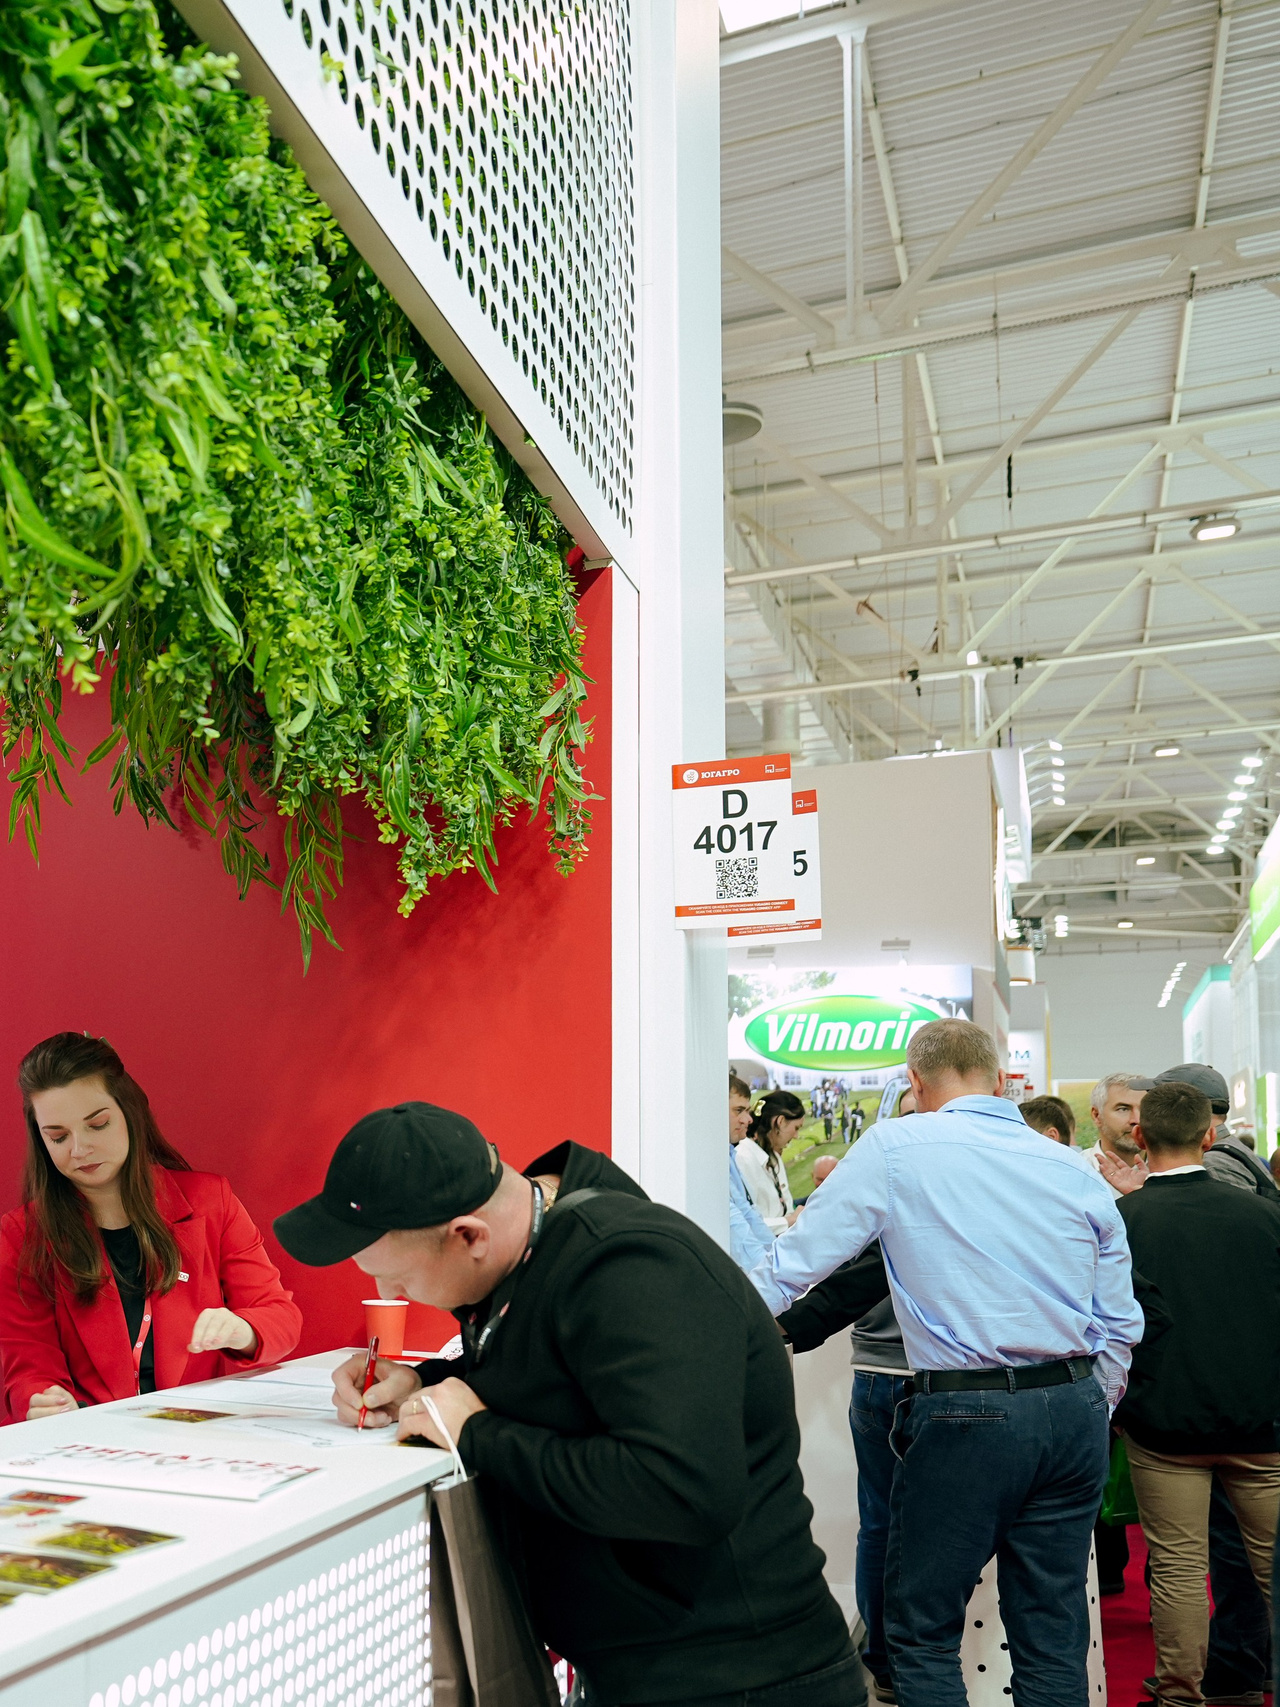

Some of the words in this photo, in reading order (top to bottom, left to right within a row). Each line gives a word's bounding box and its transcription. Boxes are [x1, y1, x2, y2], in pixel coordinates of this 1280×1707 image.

[701, 769, 740, 779] ЮГАГРО
[722, 789, 748, 819] D
[693, 821, 778, 854] 4017
[793, 850, 808, 876] 5
[1002, 1088, 1020, 1096] 013
